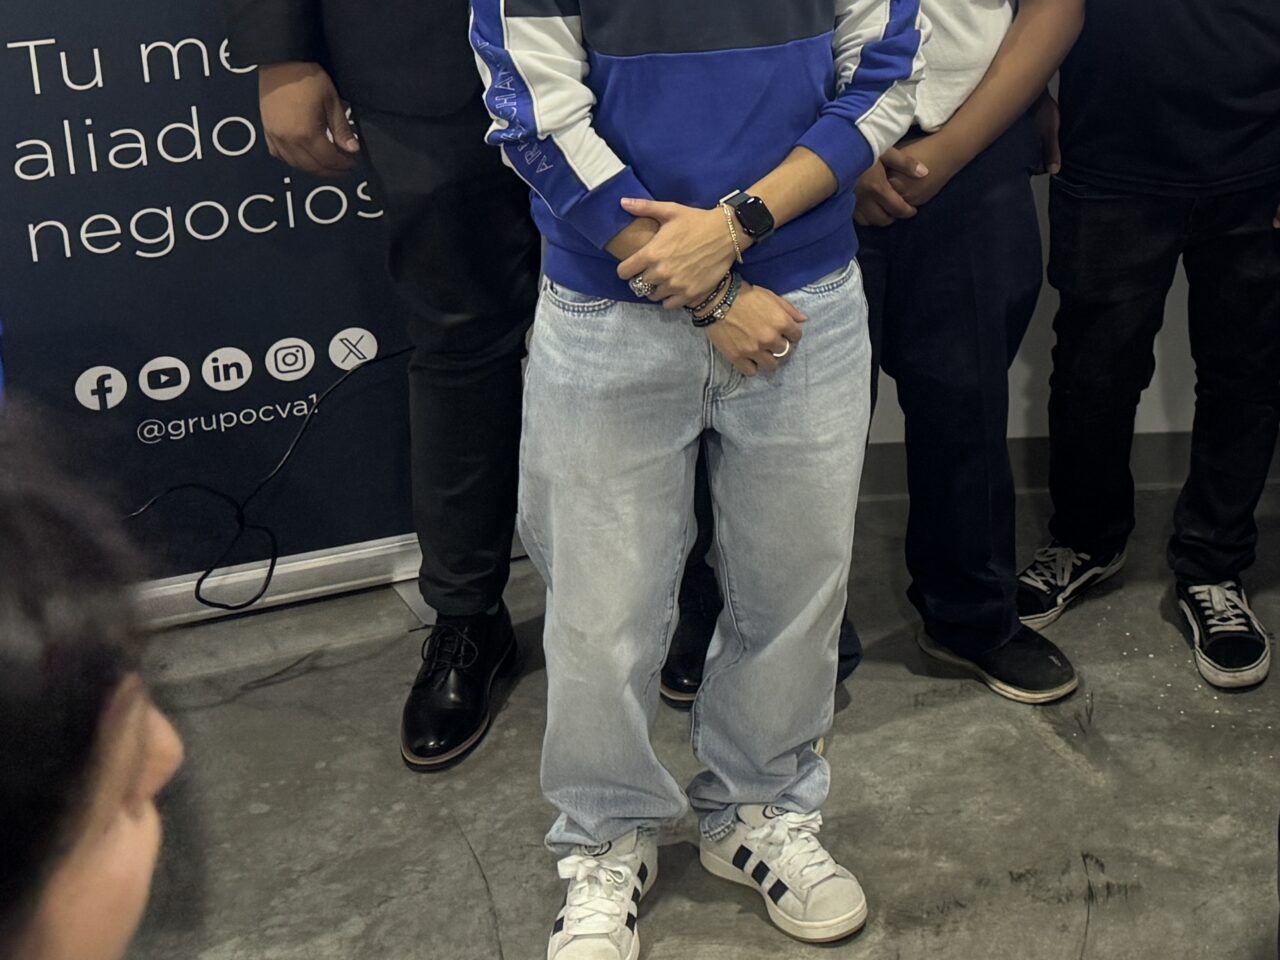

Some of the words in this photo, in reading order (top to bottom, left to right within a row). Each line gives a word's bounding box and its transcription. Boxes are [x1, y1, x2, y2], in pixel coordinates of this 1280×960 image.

[7, 37, 104, 96] Tu
[13, 105, 258, 182] aliado
[27, 176, 385, 263] negocios
